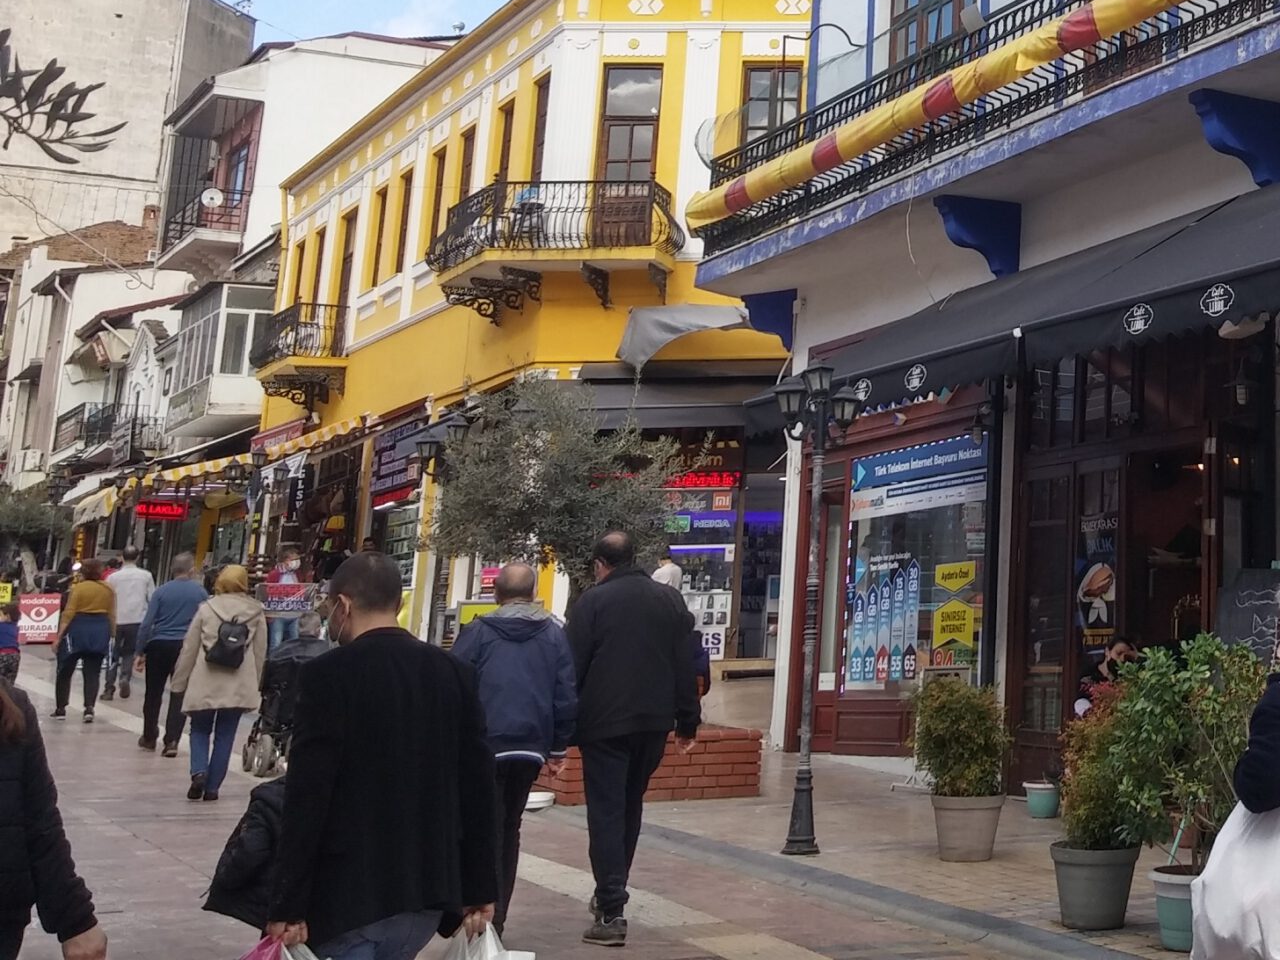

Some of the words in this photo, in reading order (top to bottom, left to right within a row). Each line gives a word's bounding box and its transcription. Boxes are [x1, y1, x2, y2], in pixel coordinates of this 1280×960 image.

[874, 466, 887, 477] Türk
[887, 462, 910, 474] Telekom
[910, 456, 933, 470] İnternet
[933, 452, 958, 467] Başvuru
[958, 448, 982, 460] Noktası
[909, 567, 918, 579] 30
[959, 568, 970, 579] Özel
[896, 577, 904, 589] 15
[908, 580, 918, 591] GB
[869, 592, 876, 604] 6
[882, 587, 890, 598] 10
[894, 589, 904, 601] GB
[20, 597, 60, 605] vodafone
[857, 600, 862, 611] 3
[881, 598, 890, 610] GB
[867, 605, 877, 616] GB
[854, 612, 863, 622] GB
[851, 658, 861, 672] 33
[864, 657, 875, 672] 37
[877, 656, 888, 671] 44
[891, 656, 901, 671] 55
[904, 655, 915, 671] 65
